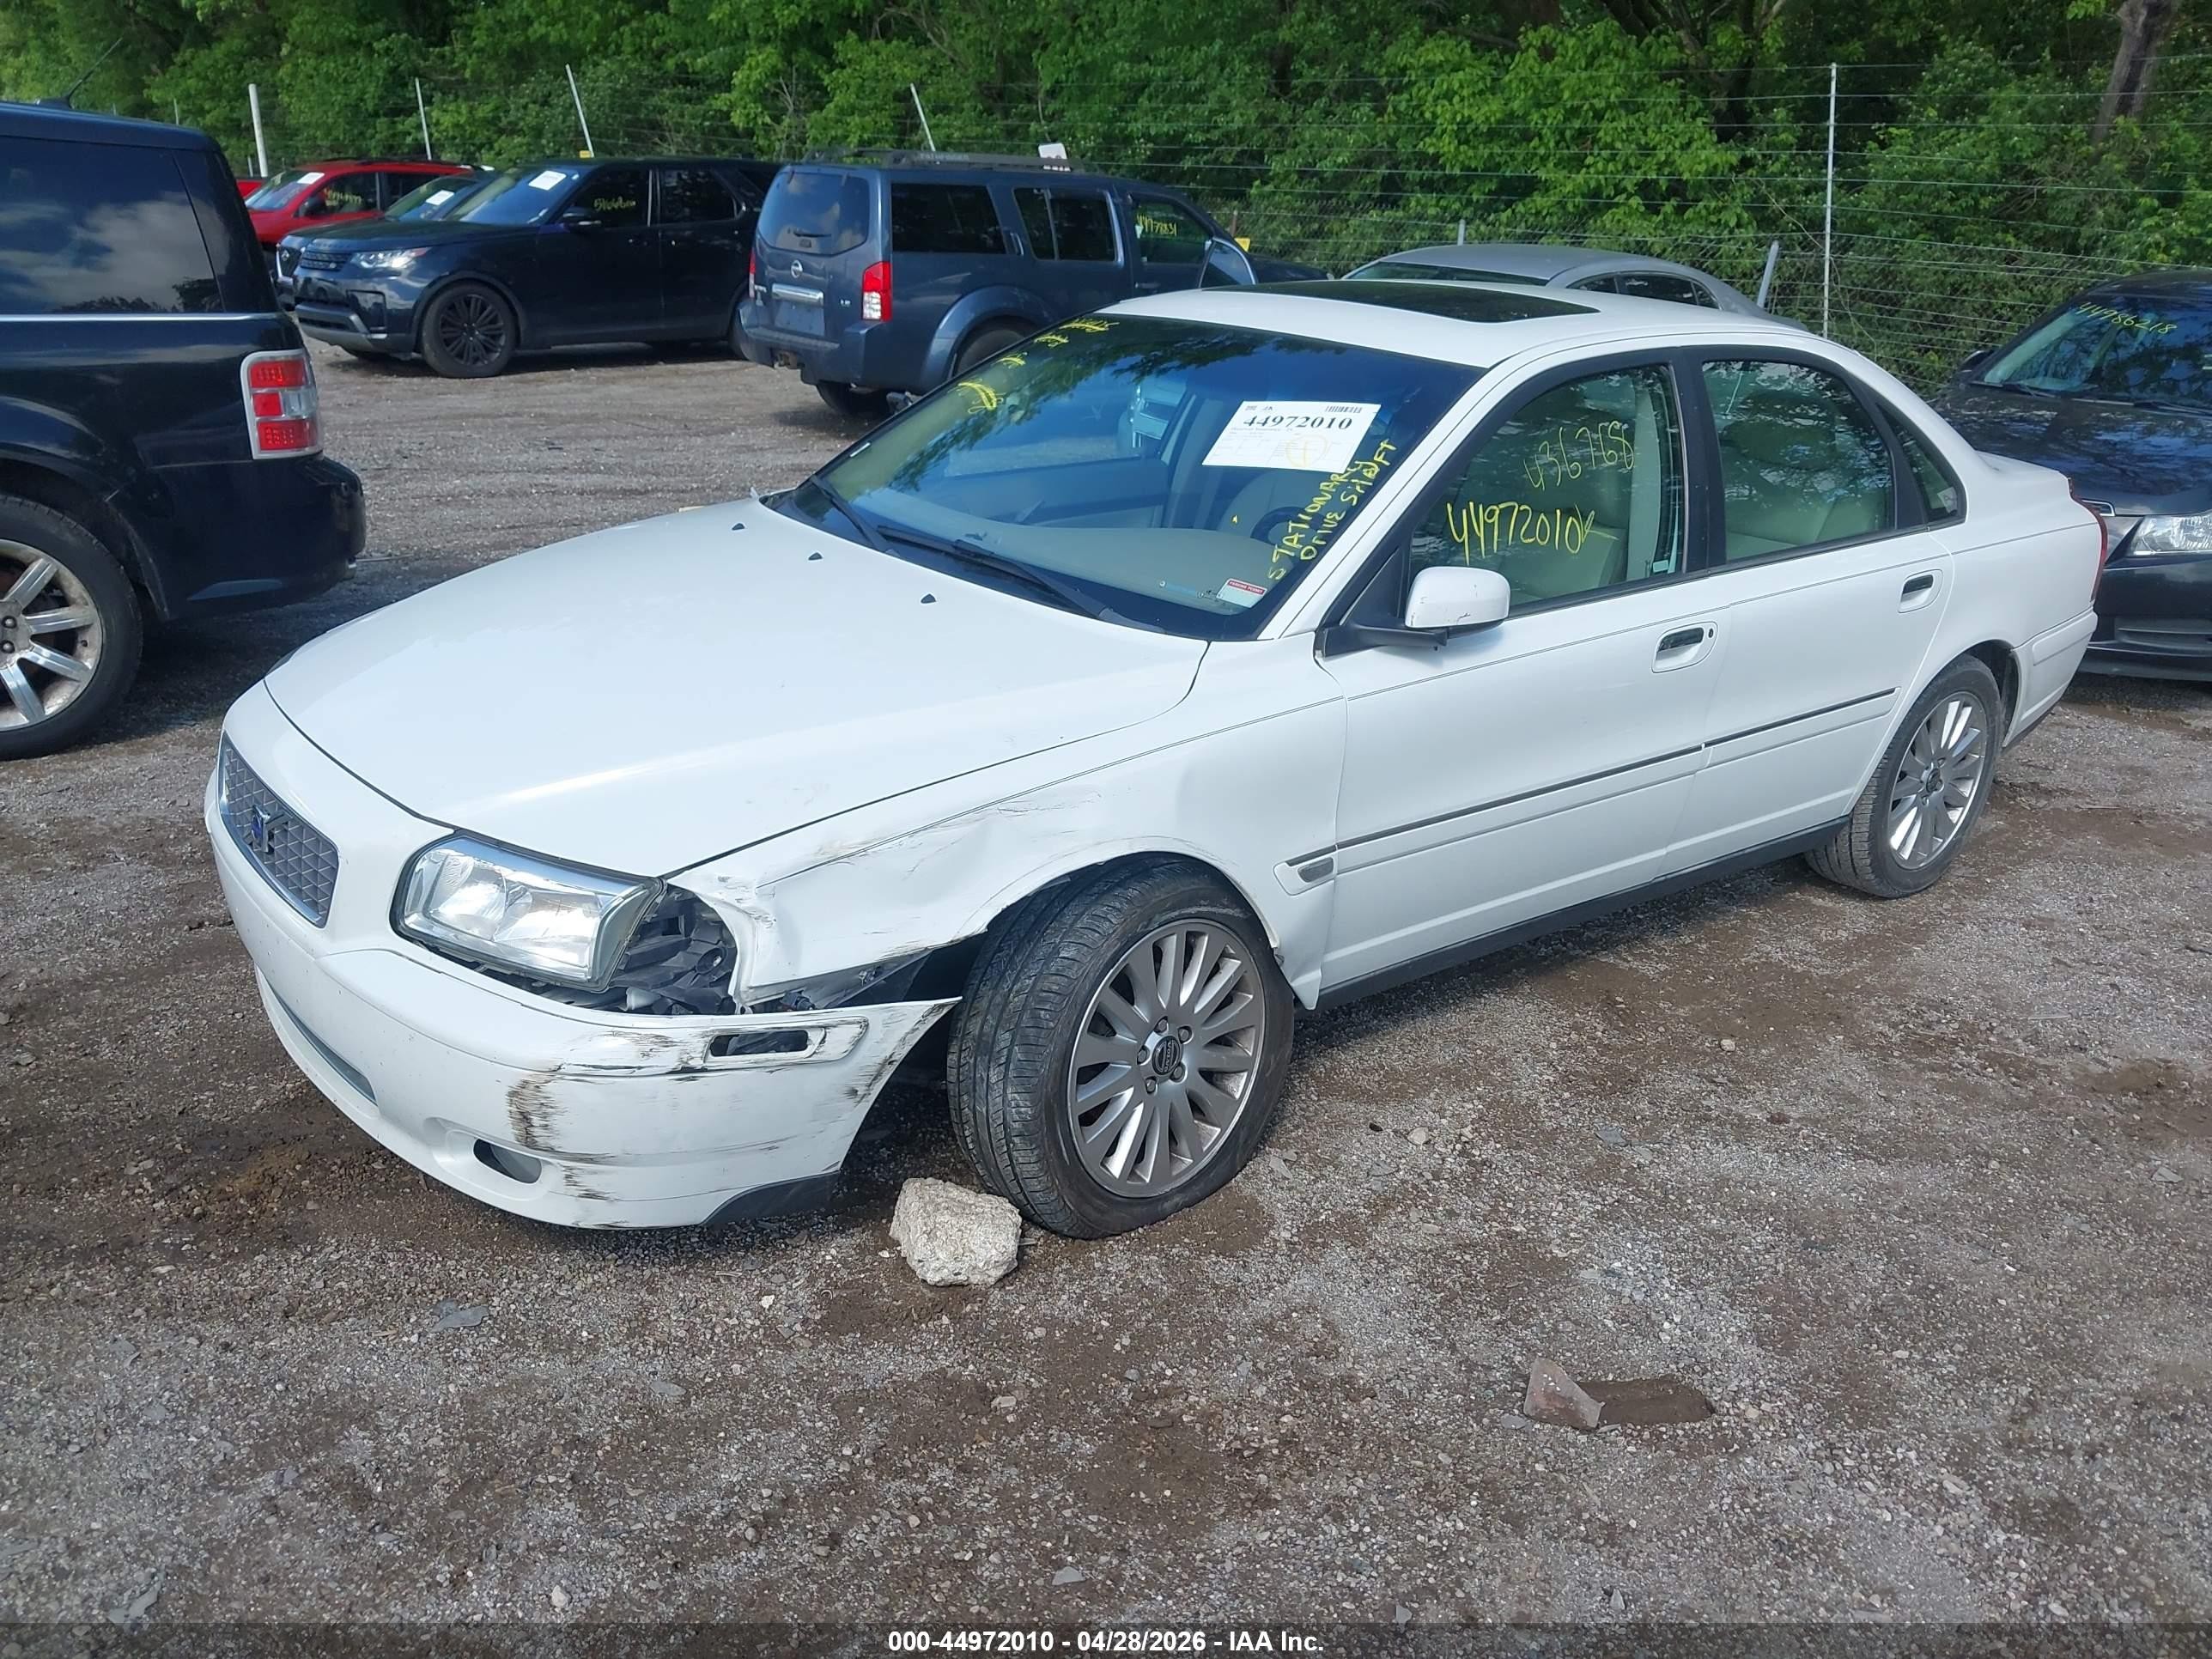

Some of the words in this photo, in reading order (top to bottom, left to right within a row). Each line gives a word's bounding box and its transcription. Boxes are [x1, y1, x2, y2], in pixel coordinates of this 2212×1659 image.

[2075, 301, 2178, 334] 44986218
[1243, 415, 1353, 430] 44972010
[1523, 420, 1635, 491] 436768
[1267, 461, 1371, 580] STATIONARY
